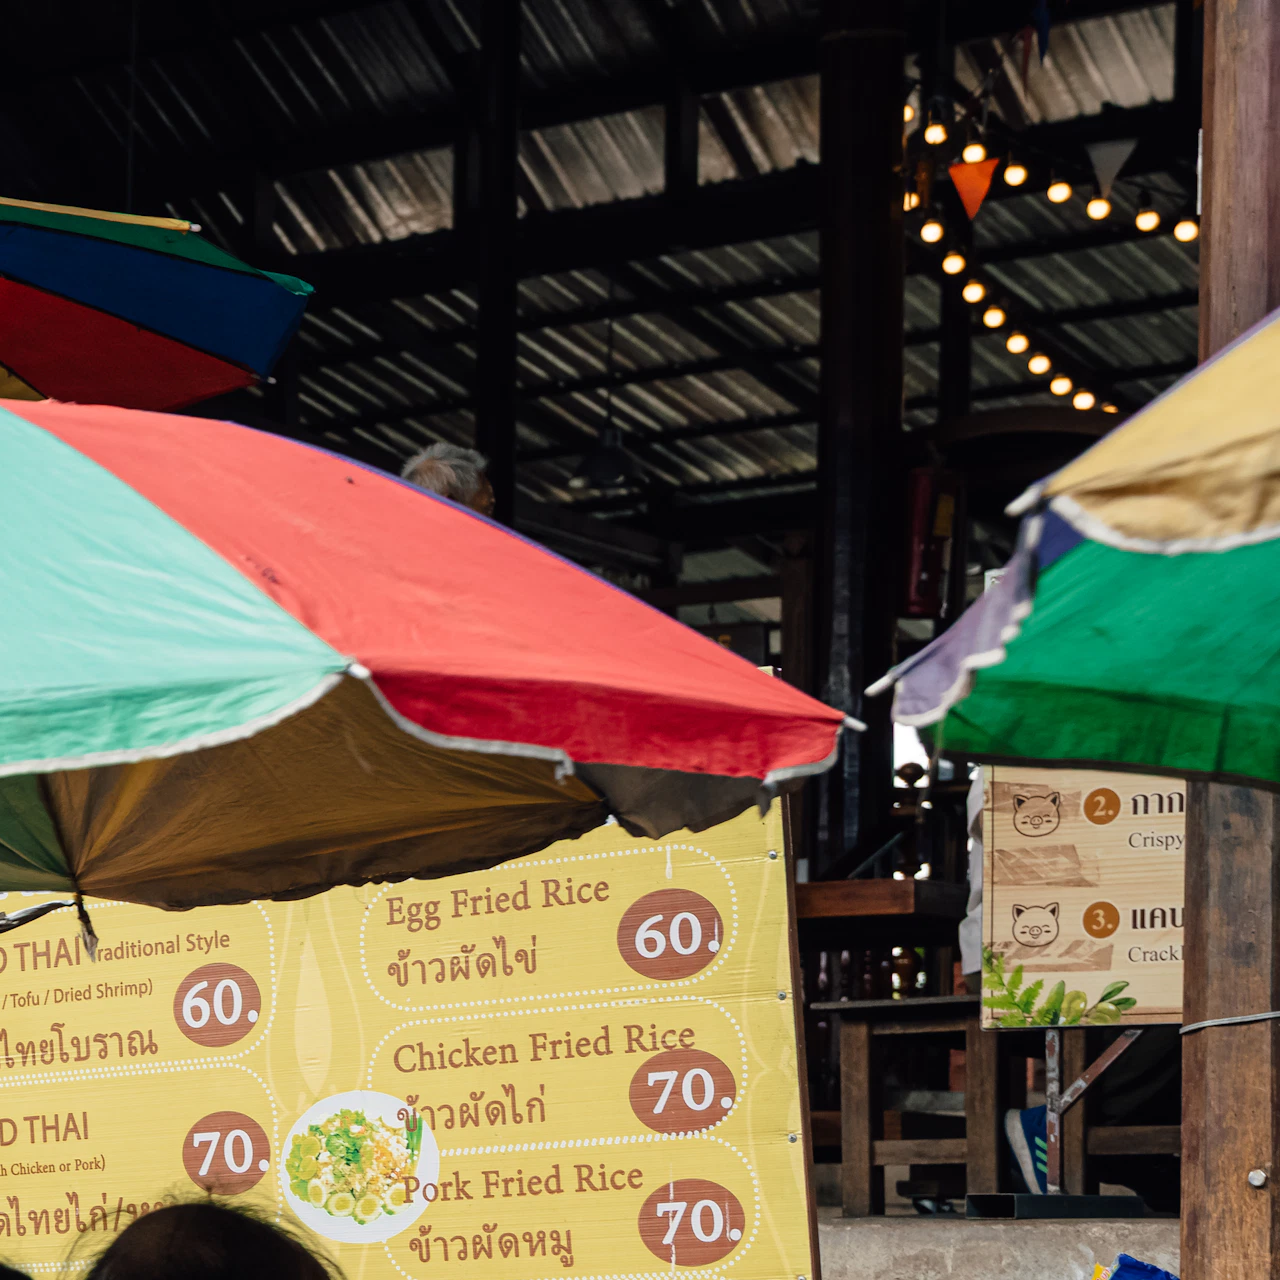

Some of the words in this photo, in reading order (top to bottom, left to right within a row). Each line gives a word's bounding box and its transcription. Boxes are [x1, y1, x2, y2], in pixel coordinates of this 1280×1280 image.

[1130, 792, 1184, 816] กาก
[1128, 831, 1185, 851] Crispy
[386, 897, 441, 932] Egg
[451, 884, 531, 919] Fried
[541, 878, 610, 908] Rice
[13, 936, 81, 972] THAI
[96, 934, 180, 962] raditional
[186, 930, 230, 955] Style
[635, 912, 720, 959] 60.
[387, 935, 537, 988] ข้าวผัดไข่
[10, 991, 40, 1008] Tofu
[53, 985, 92, 1004] Dried
[96, 978, 153, 999] Shrimp)
[182, 979, 259, 1029] 60.
[393, 1037, 519, 1073] Chicken
[529, 1029, 613, 1062] Fried
[623, 1023, 696, 1054] Rice
[397, 1084, 546, 1132] ข้าวผัดไก่
[647, 1067, 733, 1115] 70.
[23, 1111, 89, 1145] THAI
[10, 1161, 56, 1176] Chicken
[59, 1163, 72, 1173] or
[75, 1155, 106, 1173] Pork)
[193, 1129, 270, 1177] 70.
[402, 1171, 473, 1205] Pork
[482, 1167, 565, 1199] Fried
[573, 1163, 644, 1193] Rice
[408, 1223, 575, 1268] ข้าวผัดหมู
[656, 1200, 742, 1246] 70.
